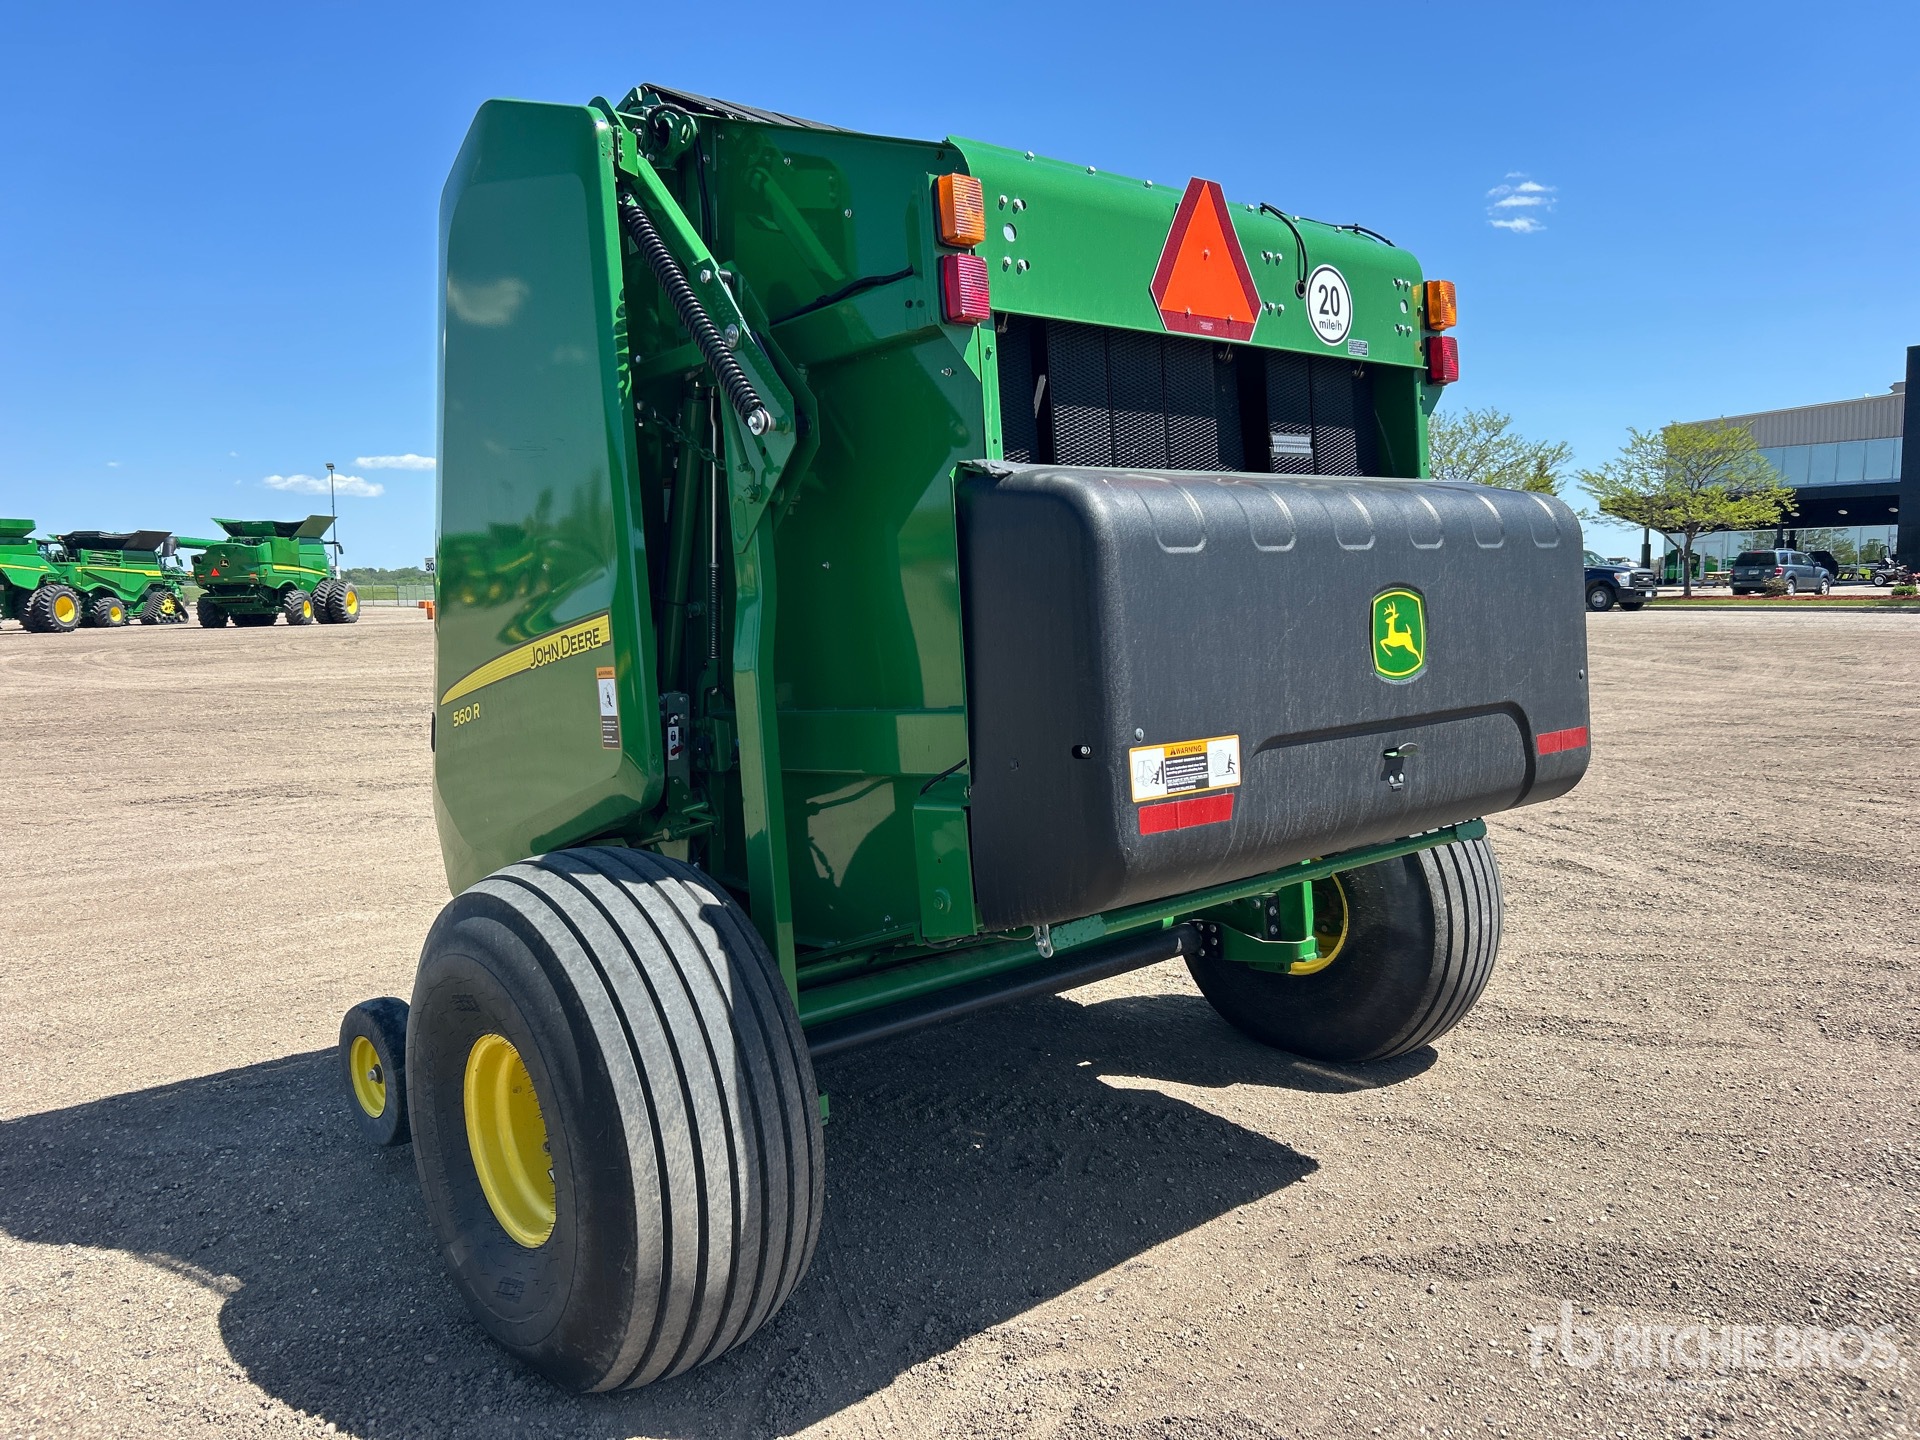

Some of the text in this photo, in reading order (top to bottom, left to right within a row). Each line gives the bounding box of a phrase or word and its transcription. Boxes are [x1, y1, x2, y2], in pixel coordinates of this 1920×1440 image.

[1318, 284, 1340, 317] 20
[1319, 319, 1342, 331] mile/h
[530, 627, 601, 668] JOHN DEERE
[453, 702, 480, 728] 560 R
[1176, 745, 1202, 755] WARNING
